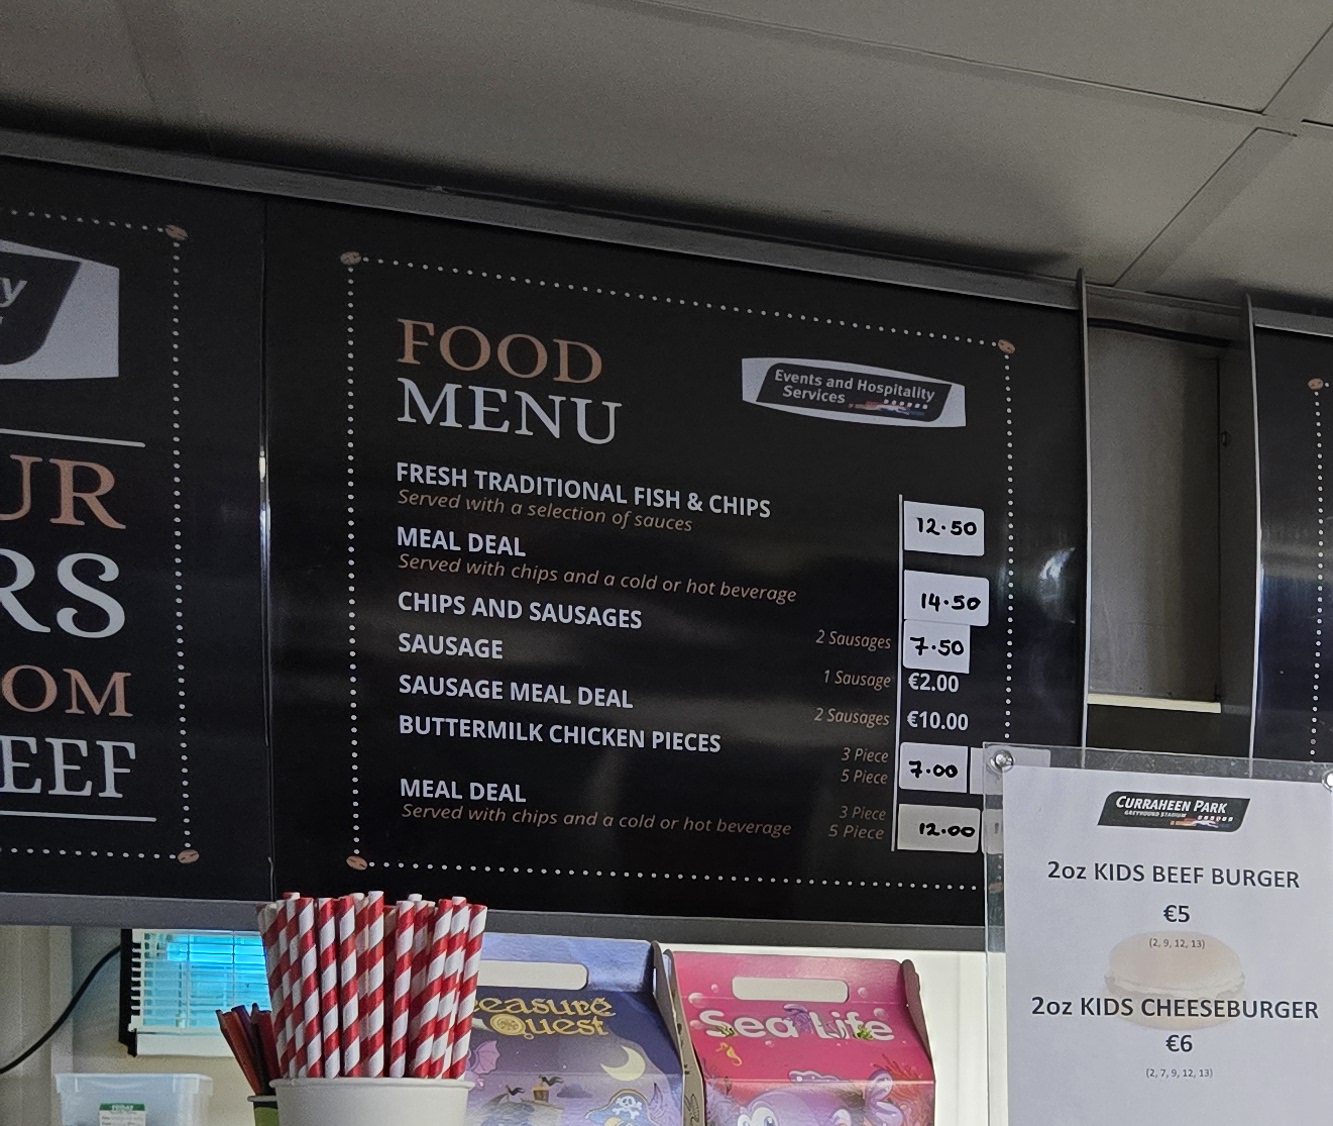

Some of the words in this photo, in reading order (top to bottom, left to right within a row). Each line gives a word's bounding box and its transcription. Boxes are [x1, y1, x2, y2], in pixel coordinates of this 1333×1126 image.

[397, 318, 602, 383] FOOD
[774, 369, 823, 388] Events
[826, 376, 853, 390] and
[857, 379, 935, 403] Hospitality
[783, 385, 846, 404] Services
[397, 378, 622, 444] MENU
[397, 462, 467, 488] FRESH
[474, 470, 627, 504] TRADITIONAL
[634, 486, 680, 510] FISH
[687, 492, 703, 511] &
[709, 495, 771, 518] CHIPS
[397, 526, 461, 551] MEAL
[468, 533, 526, 557] DEAL
[398, 591, 466, 616] CHIPS
[472, 598, 523, 620] AND
[529, 603, 643, 629] SAUSAGES
[398, 633, 504, 660] SAUSAGE
[399, 674, 504, 700] SAUSAGE
[510, 682, 571, 706] MEAL
[578, 687, 634, 709] DEAL
[908, 673, 960, 693] €2.00
[399, 715, 543, 743] BUTTERMILK
[549, 724, 645, 749] CHICKEN
[652, 730, 721, 753] PIECES
[907, 711, 969, 731] €10.00
[400, 779, 462, 800] MEAL
[469, 783, 526, 803] DEAL
[1116, 795, 1191, 812] CURRAHEEN
[1193, 800, 1227, 814] PARK
[1047, 861, 1086, 880] 2oz
[1094, 863, 1145, 882] KIDS
[1152, 866, 1204, 884] BEEF
[1211, 868, 1300, 889] BURGER
[1163, 905, 1190, 923] €5
[1031, 997, 1072, 1016] 2oz
[1080, 997, 1133, 1016] KIDS
[1141, 998, 1319, 1019] CHEESEBURGER
[489, 1014, 609, 1040] Quest
[699, 1008, 798, 1039] Sea
[814, 1009, 895, 1042] Life
[1165, 1035, 1193, 1053] €6
